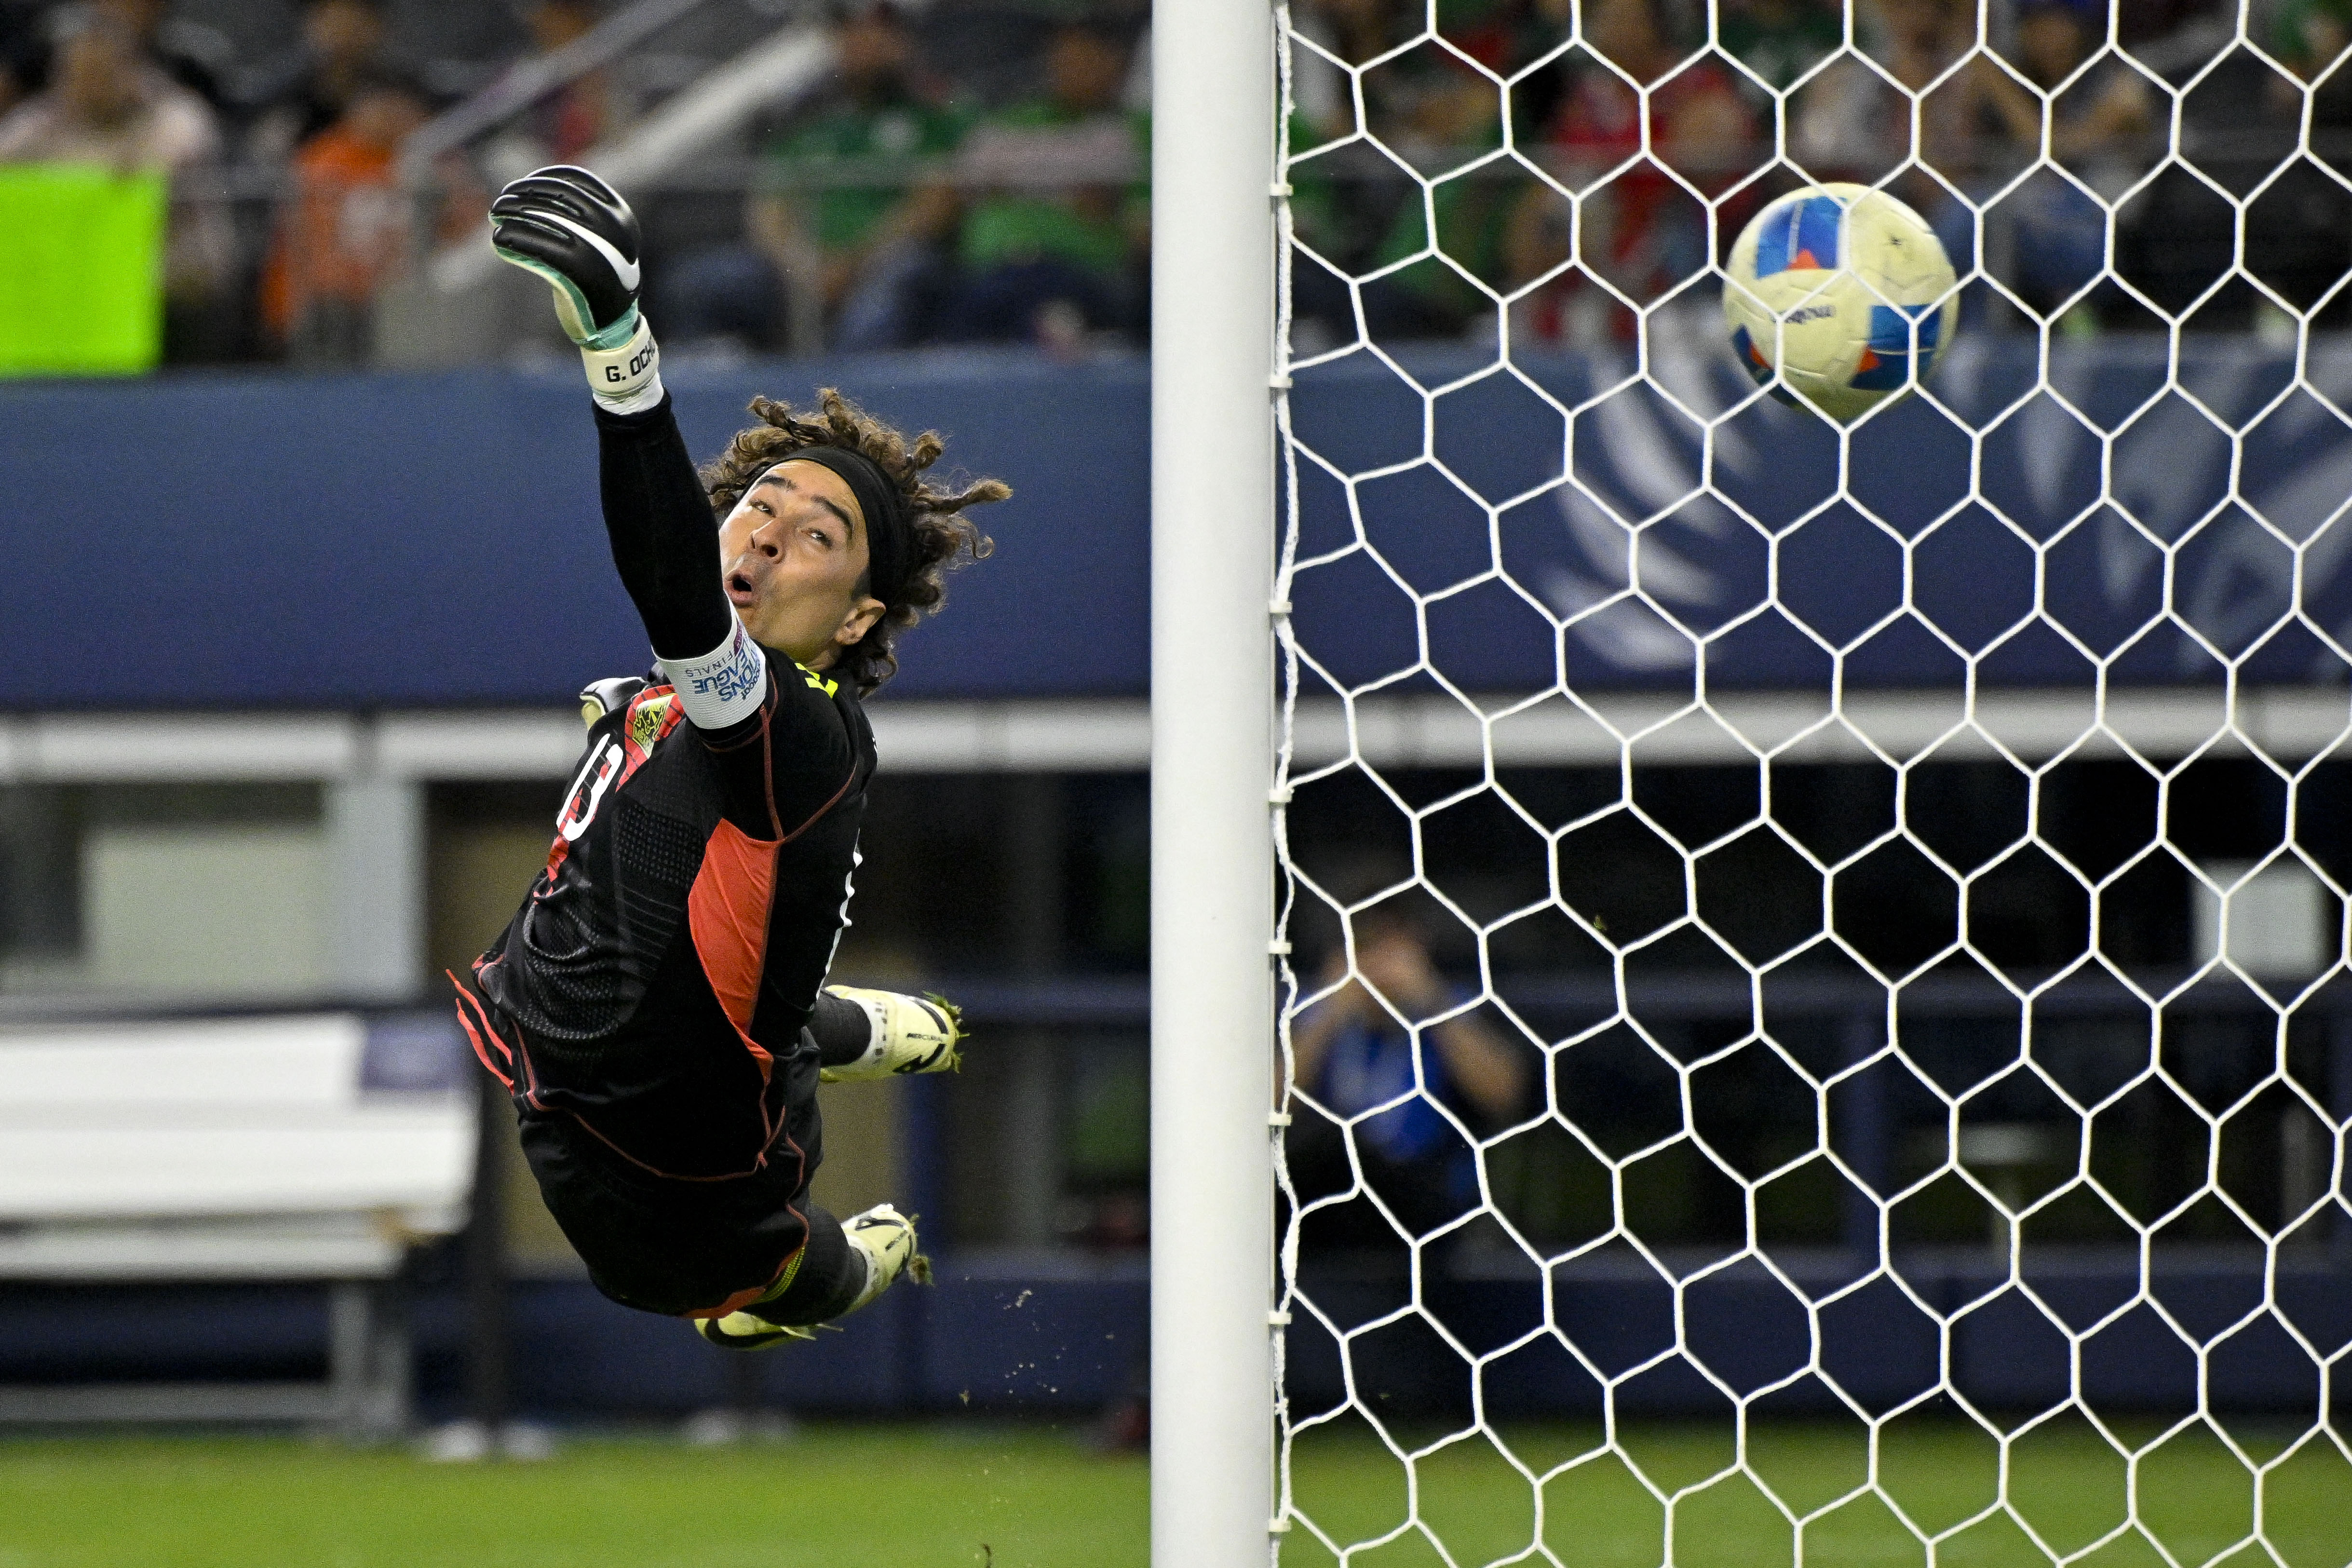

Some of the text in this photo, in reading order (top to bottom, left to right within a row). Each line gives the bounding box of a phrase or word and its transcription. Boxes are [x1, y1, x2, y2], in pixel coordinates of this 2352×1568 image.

[605, 365, 626, 382] G.
[685, 651, 733, 677] FINALS
[556, 733, 623, 841] 13
